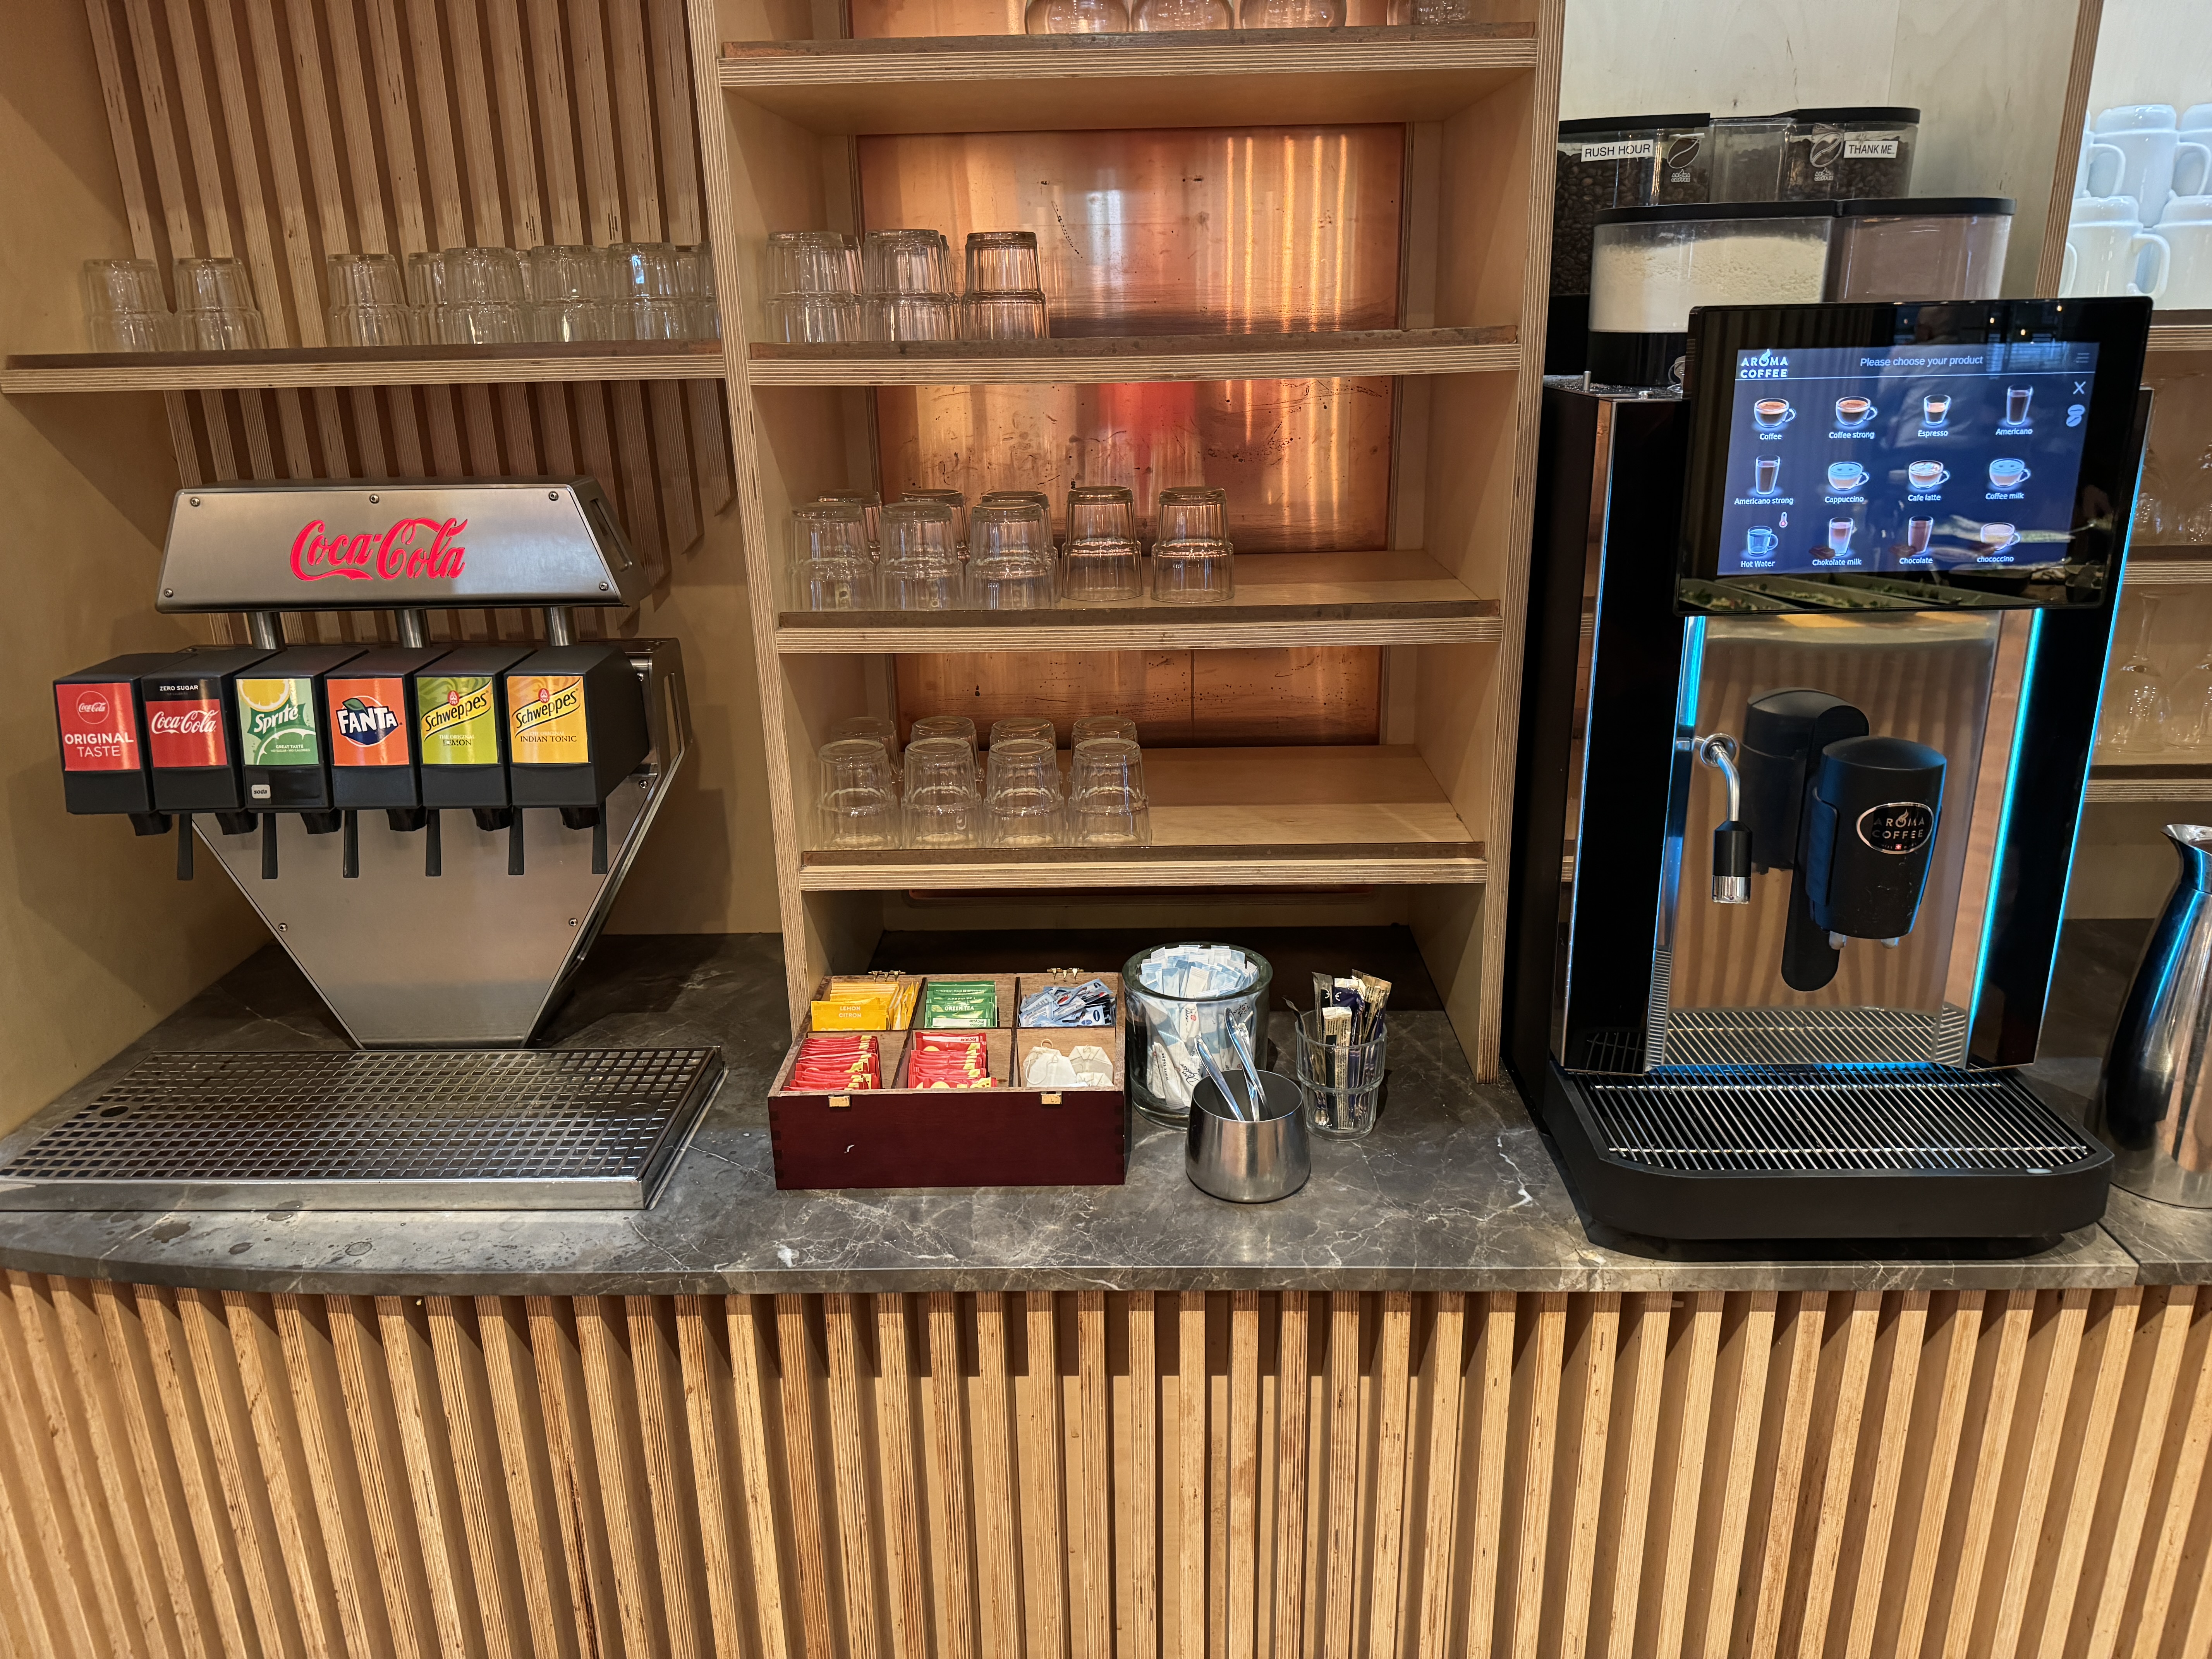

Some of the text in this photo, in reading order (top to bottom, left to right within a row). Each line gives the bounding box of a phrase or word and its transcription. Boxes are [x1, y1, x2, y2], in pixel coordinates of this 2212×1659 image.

[1585, 144, 1650, 158] RUSH HOUR
[1849, 144, 1879, 154] THANK
[1741, 353, 1788, 367] AROMA
[1860, 356, 1983, 367] Please choose your product
[1740, 369, 1788, 378] COFFEE
[1824, 496, 1864, 504] Cappuccino
[290, 517, 468, 581] Coca-Cola
[79, 702, 106, 713] Coca-Cola
[425, 693, 487, 732] Schweppes
[516, 691, 577, 728] Schweppes
[151, 710, 220, 734] Coca-Cola
[254, 704, 299, 734] Sprite
[337, 708, 397, 734] FANTA
[65, 732, 134, 744] ORIGINAL
[77, 746, 121, 757] TASTE
[1874, 812, 1925, 828] AROMA
[1872, 829, 1923, 839] COFFEE
